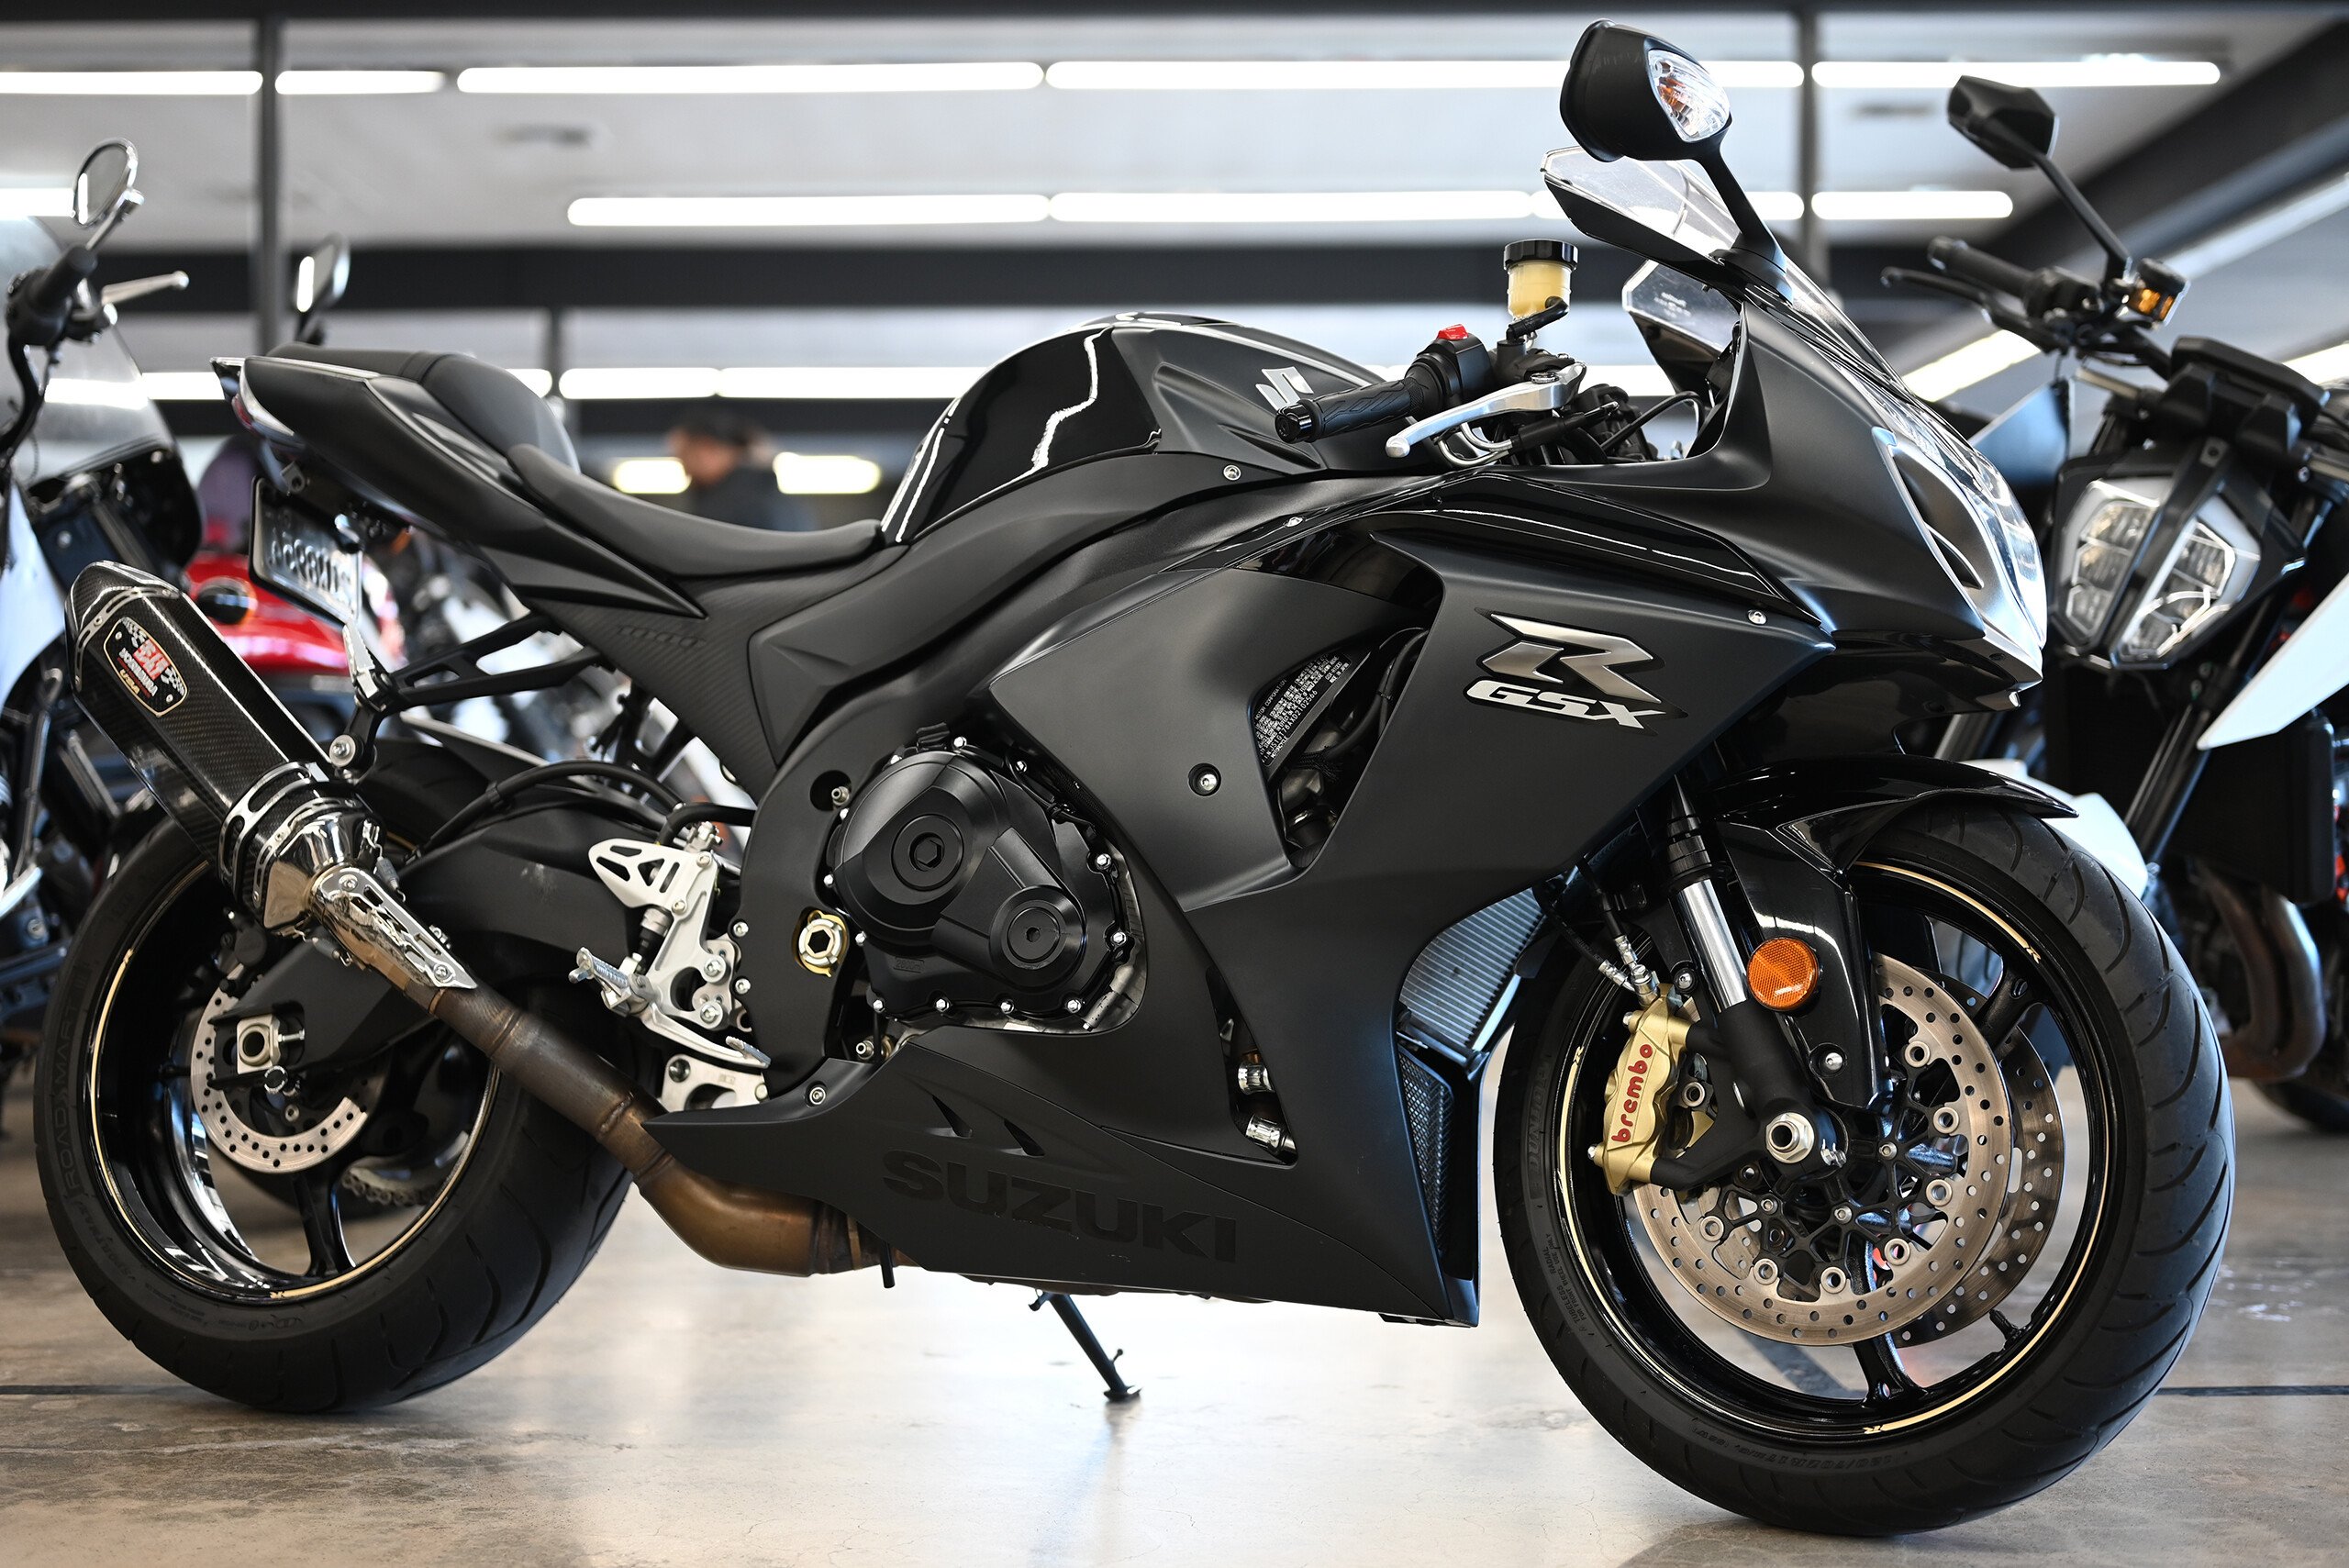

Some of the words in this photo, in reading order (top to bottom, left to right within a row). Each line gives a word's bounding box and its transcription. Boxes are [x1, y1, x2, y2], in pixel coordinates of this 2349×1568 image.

[1466, 680, 1666, 728] GSX
[1611, 1044, 1653, 1142] brembo
[882, 1148, 1237, 1263] SUZUKI
